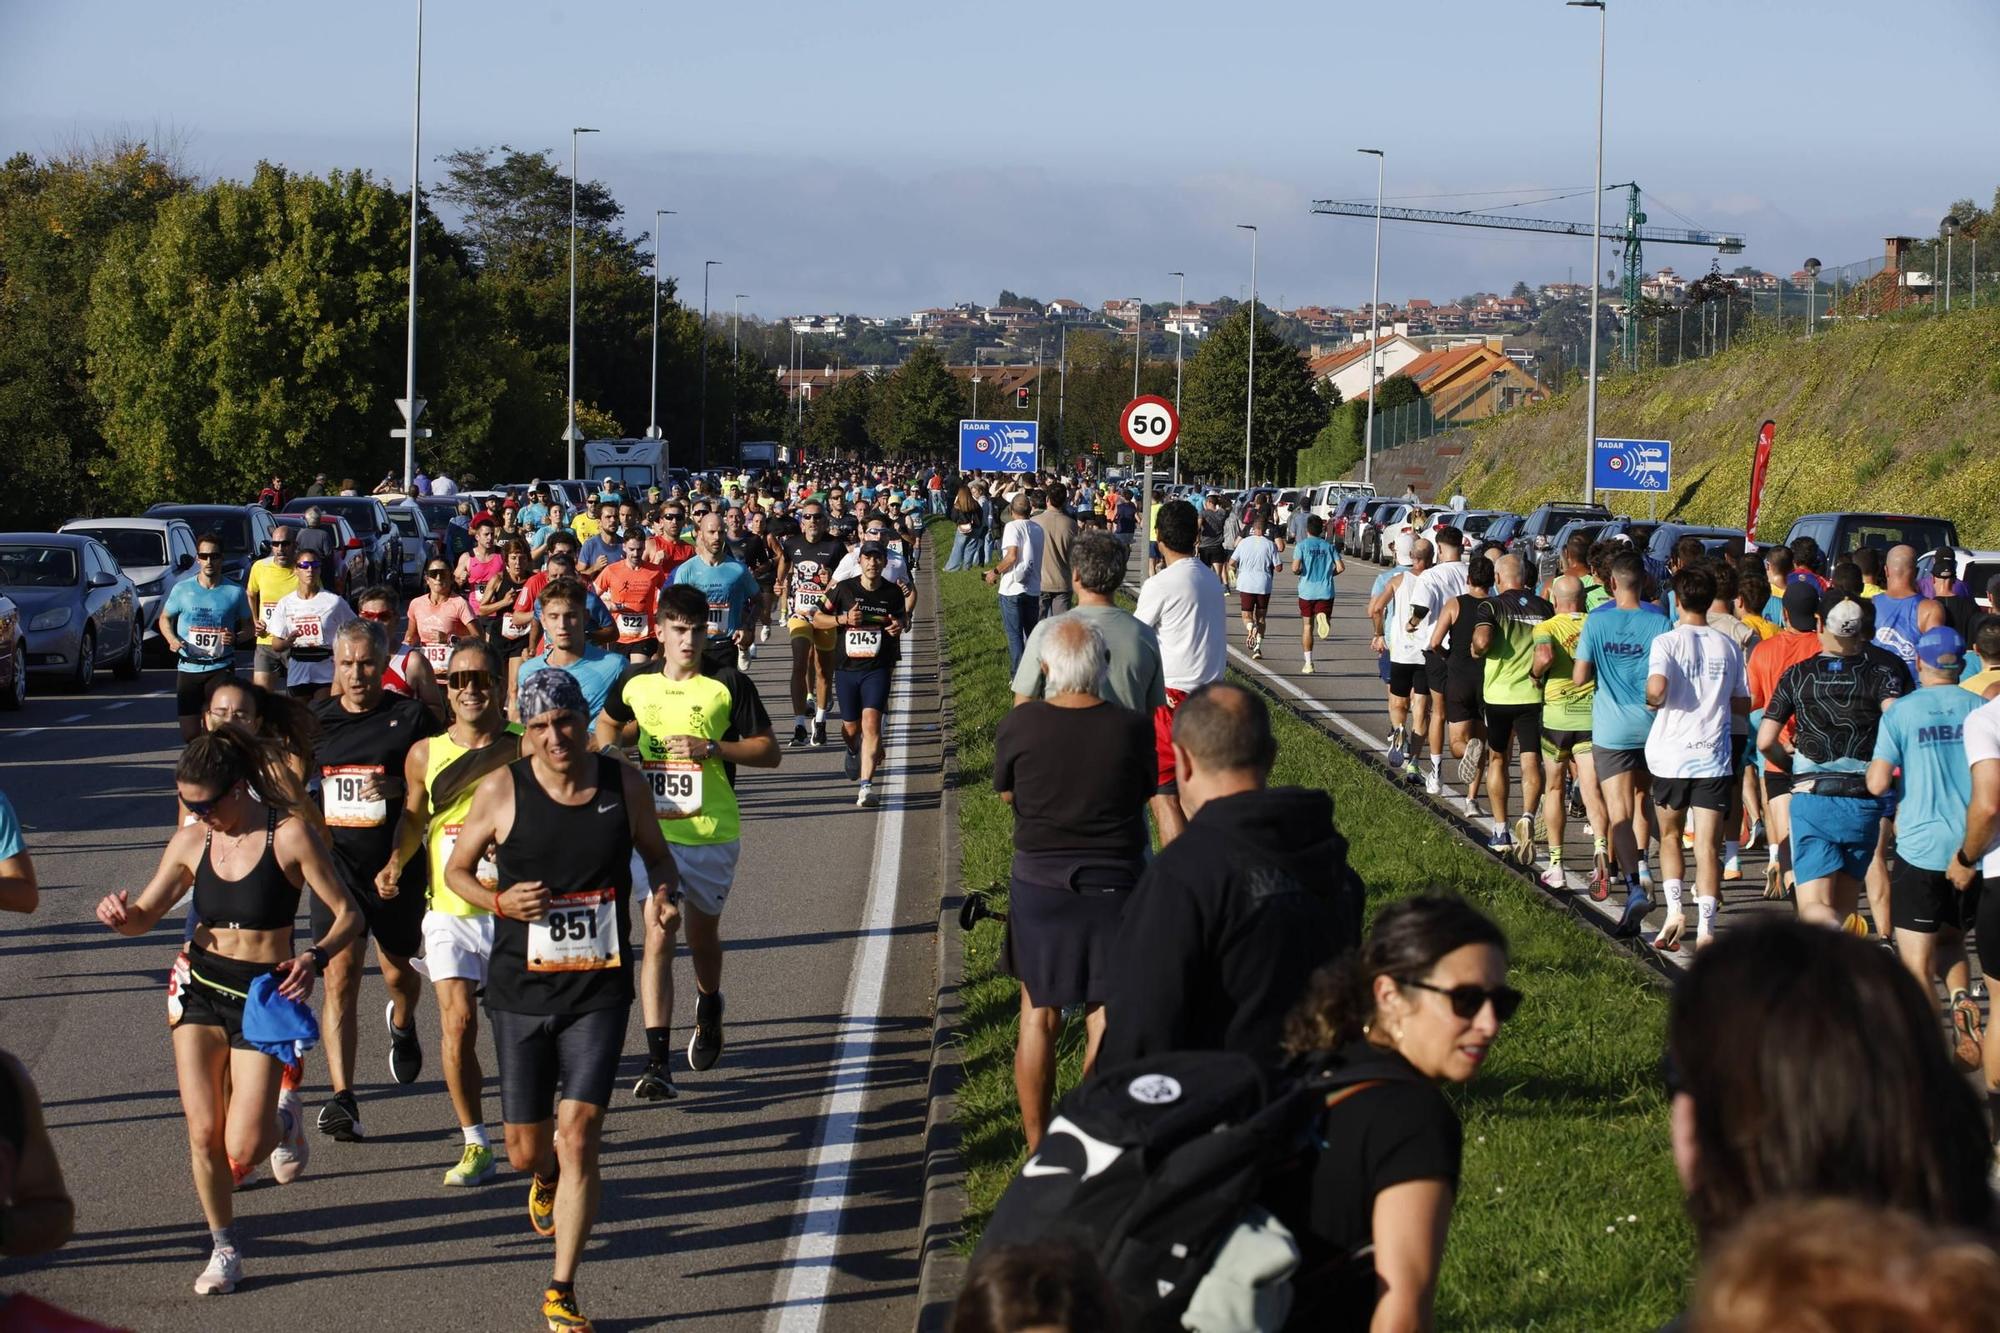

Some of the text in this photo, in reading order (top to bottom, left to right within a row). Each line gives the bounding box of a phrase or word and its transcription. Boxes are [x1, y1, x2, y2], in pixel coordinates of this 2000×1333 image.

[963, 423, 990, 431] RADAR
[1133, 416, 1166, 435] 50
[1597, 441, 1624, 449] RADAR
[623, 616, 642, 628] 922
[295, 623, 319, 637] 388
[195, 633, 218, 647] 967
[850, 632, 877, 645] 2143
[335, 777, 363, 802] 191
[646, 773, 693, 797] 1859
[548, 909, 597, 942] 851
